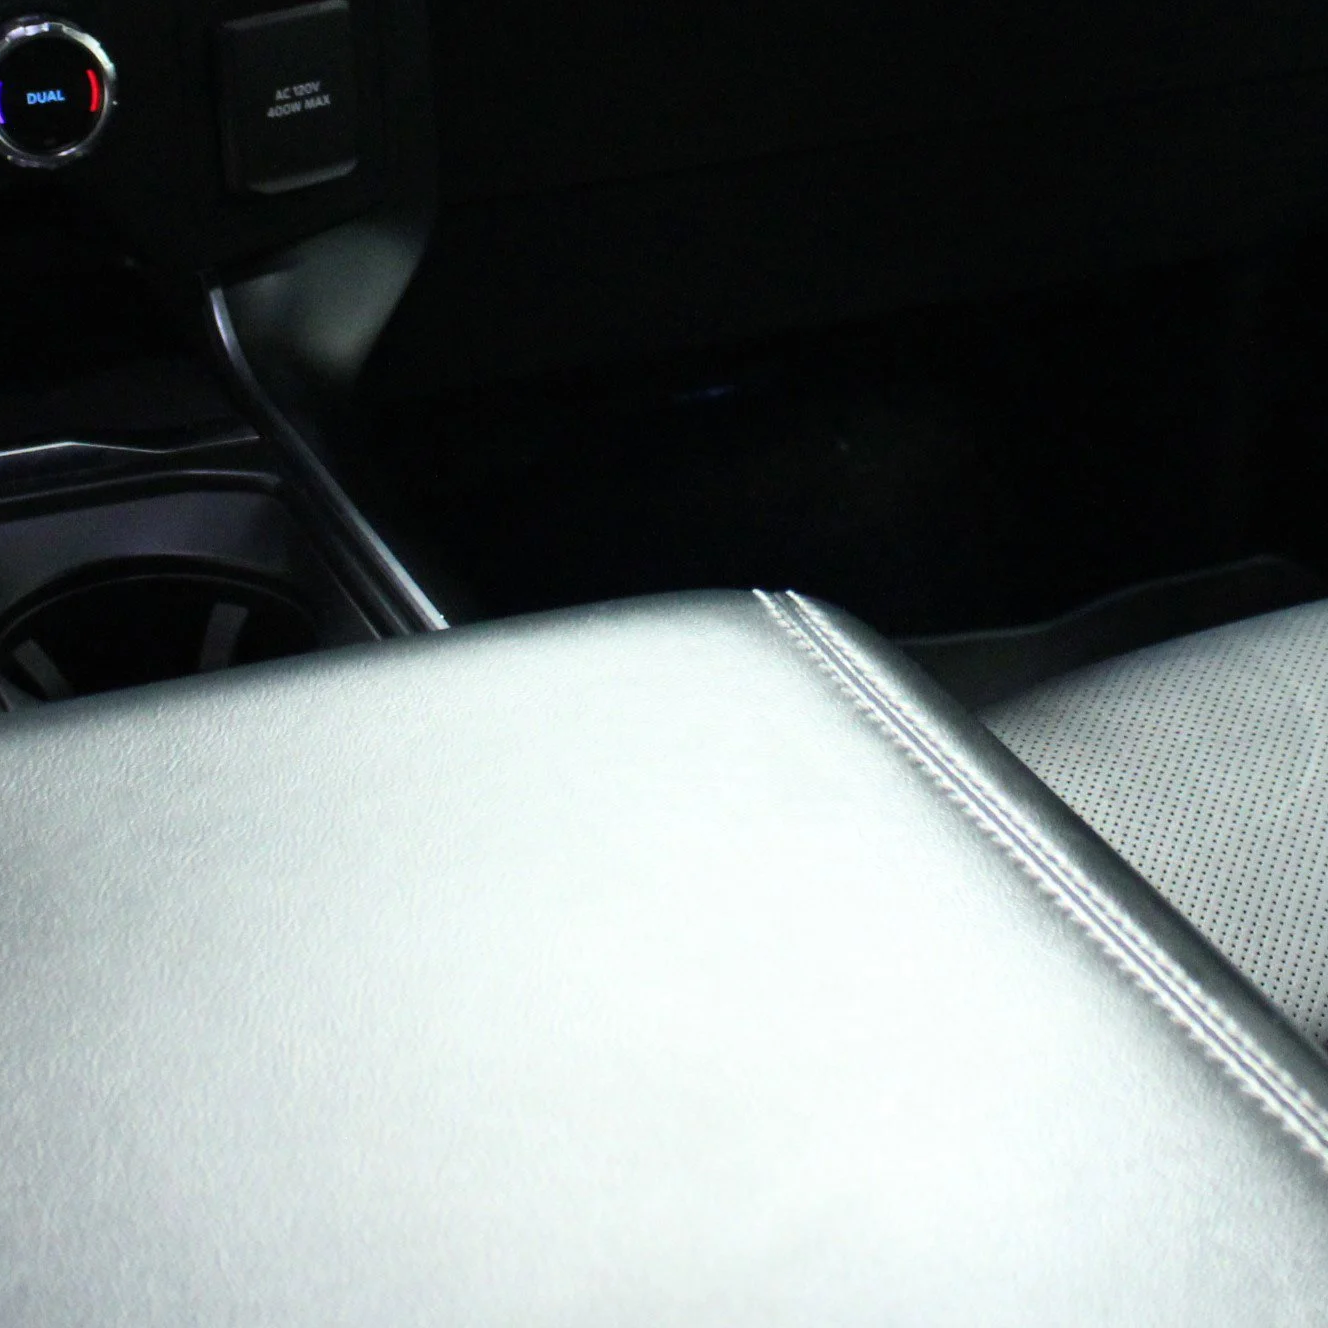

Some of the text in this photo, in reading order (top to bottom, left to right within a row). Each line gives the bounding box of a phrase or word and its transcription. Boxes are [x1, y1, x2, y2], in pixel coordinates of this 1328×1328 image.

[25, 88, 66, 106] DUAL
[275, 81, 321, 101] AC 120V
[267, 94, 331, 118] 400W MAX
